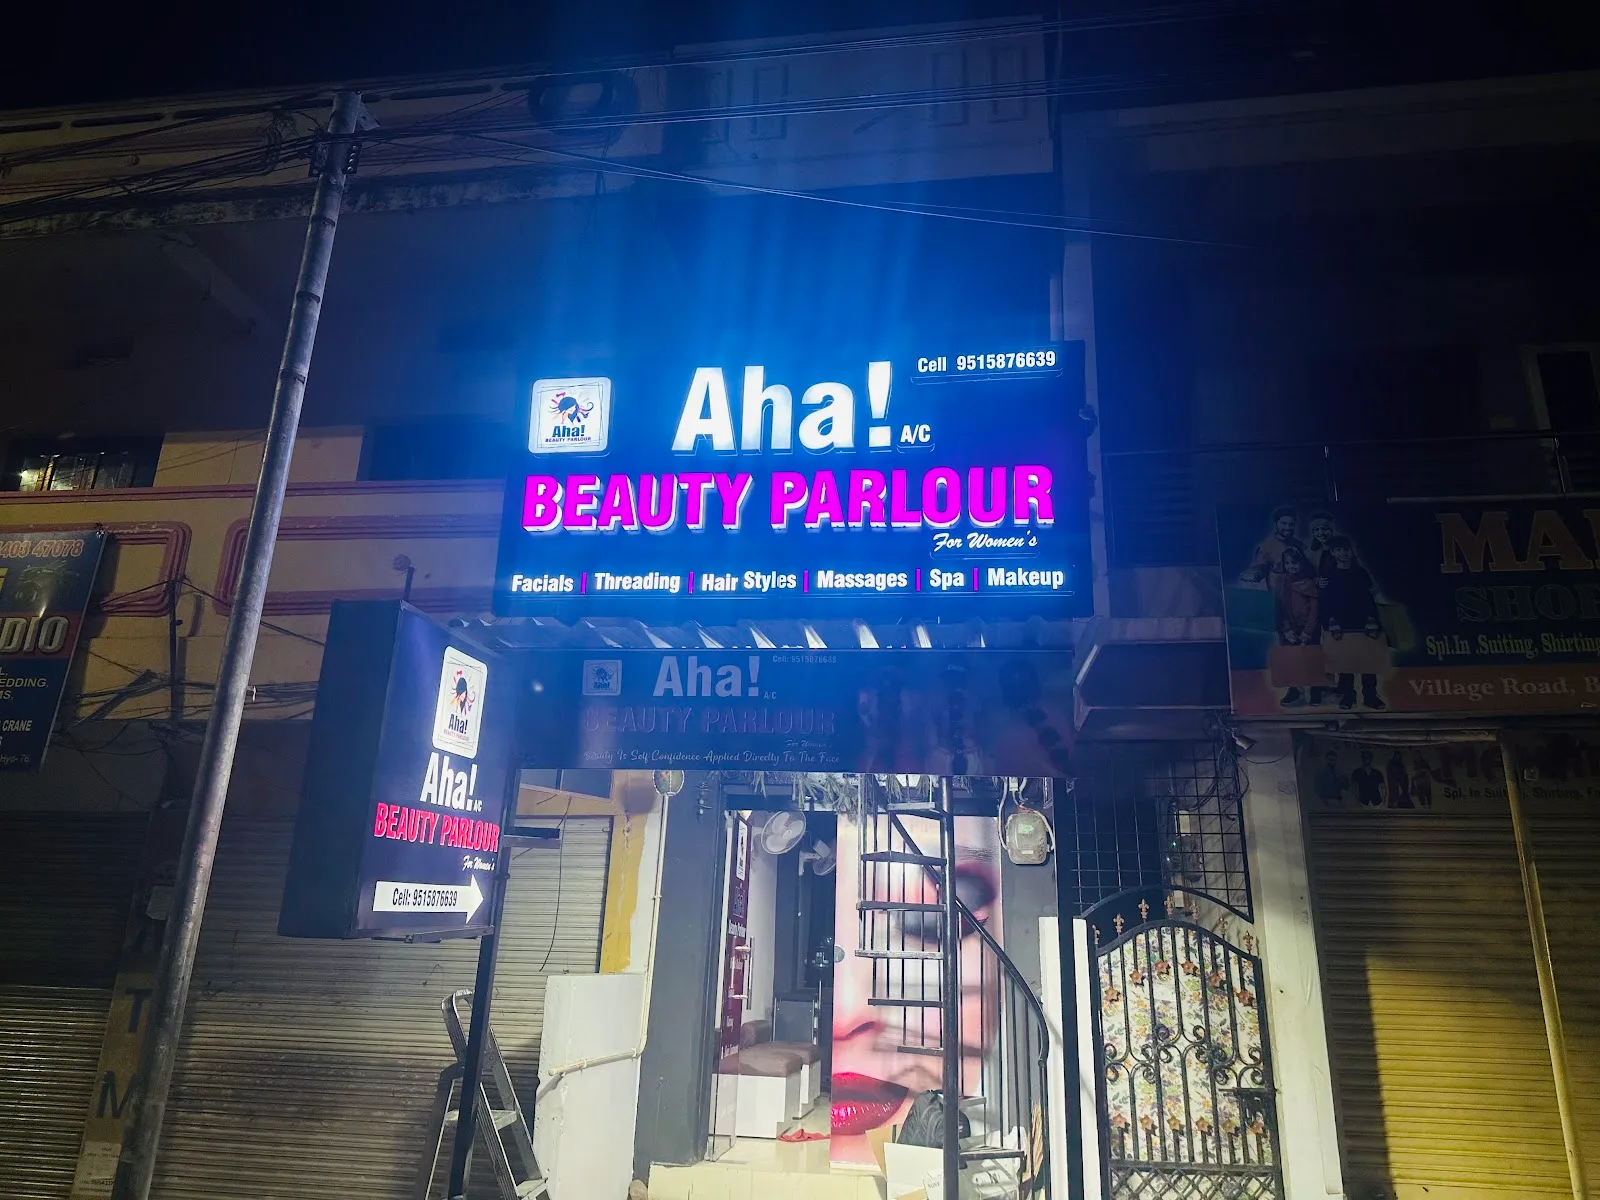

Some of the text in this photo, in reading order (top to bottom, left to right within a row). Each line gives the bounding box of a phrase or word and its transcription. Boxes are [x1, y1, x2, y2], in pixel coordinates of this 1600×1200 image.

[917, 350, 1057, 375] Cell 9515876639
[671, 361, 931, 452] Aha! A/C
[552, 424, 586, 438] Aha!
[521, 464, 1057, 532] BEAUTY PARLOUR
[32, 539, 84, 557] 47078
[932, 528, 1038, 553] For Women's
[511, 567, 1065, 594] Facials Threading Hair Styles Massages Spa Makeup
[652, 655, 760, 697] Aha!
[1409, 678, 1495, 702] Village
[1500, 676, 1577, 697] Road,
[2, 719, 33, 732] CRANE
[448, 714, 468, 734] Aha!
[585, 707, 836, 734] BEAUTY PARLOUR
[651, 751, 700, 764] Confidence
[703, 750, 740, 765] Applied
[744, 751, 780, 766] Directly
[420, 752, 478, 811] Aha!
[374, 802, 500, 853] BEAUTY PARLOUR
[392, 888, 458, 907] Cell: 9515876639
[125, 988, 154, 1032] T
